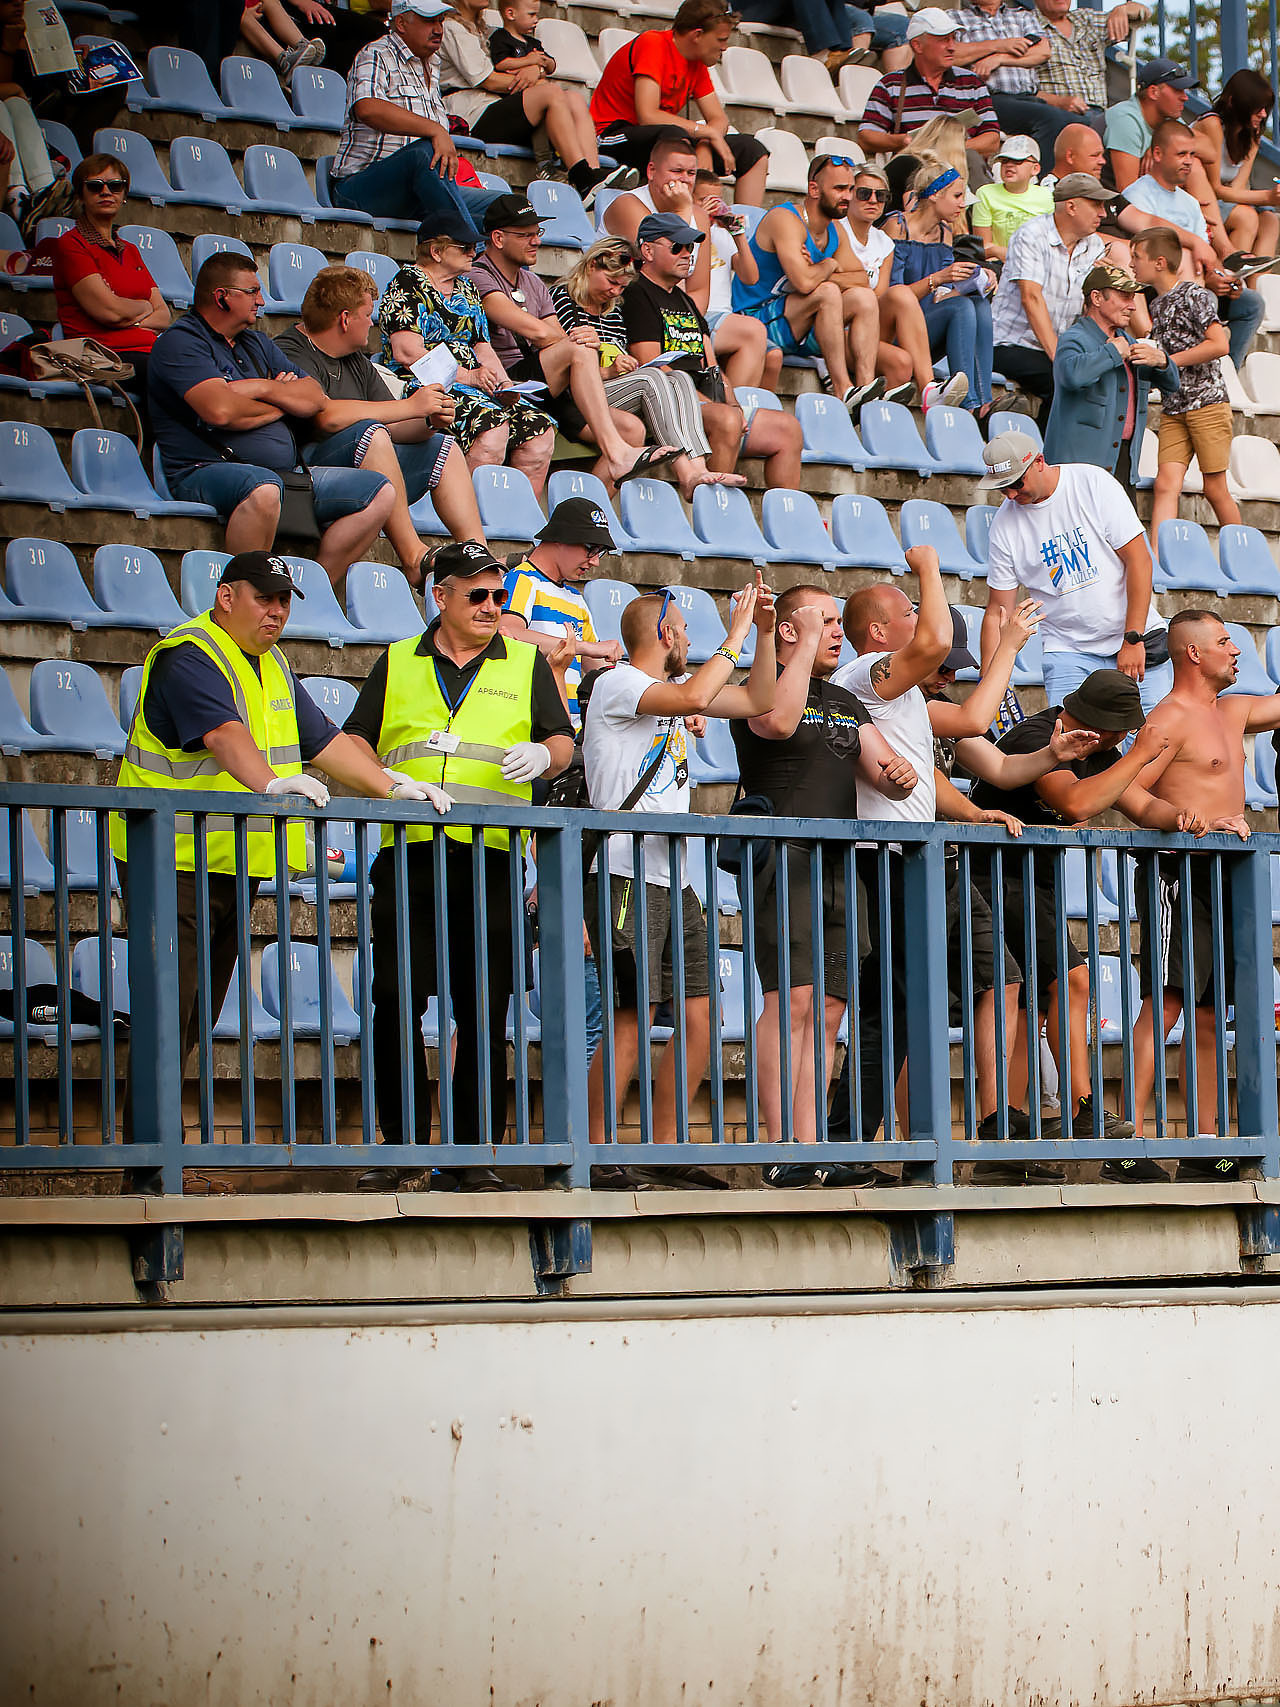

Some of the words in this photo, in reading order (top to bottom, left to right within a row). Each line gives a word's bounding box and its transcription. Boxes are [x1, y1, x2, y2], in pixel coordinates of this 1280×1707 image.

[168, 52, 181, 70] 17
[240, 64, 254, 81] 16
[311, 74, 325, 90] 15
[114, 135, 128, 153] 20
[190, 145, 203, 163] 19
[547, 188, 560, 203] 14
[138, 233, 154, 250] 22
[290, 253, 303, 271] 20
[815, 399, 827, 415] 15
[881, 405, 892, 422] 14
[944, 412, 955, 429] 13
[97, 436, 111, 454] 27
[492, 470, 510, 489] 22
[571, 476, 585, 493] 21
[638, 485, 654, 502] 20
[715, 490, 729, 511] 19
[851, 500, 863, 518] 17
[1175, 525, 1189, 542] 12
[1236, 530, 1249, 547] 11
[29, 548, 46, 566] 30
[124, 556, 142, 575] 29
[1060, 543, 1092, 576] MY
[373, 573, 388, 590] 26
[609, 589, 622, 606] 23
[680, 592, 694, 610] 22
[56, 671, 72, 691] 32
[323, 685, 340, 705] 29
[477, 687, 519, 702] APSARDZE
[718, 957, 733, 977] 29
[1102, 964, 1113, 984] 24
